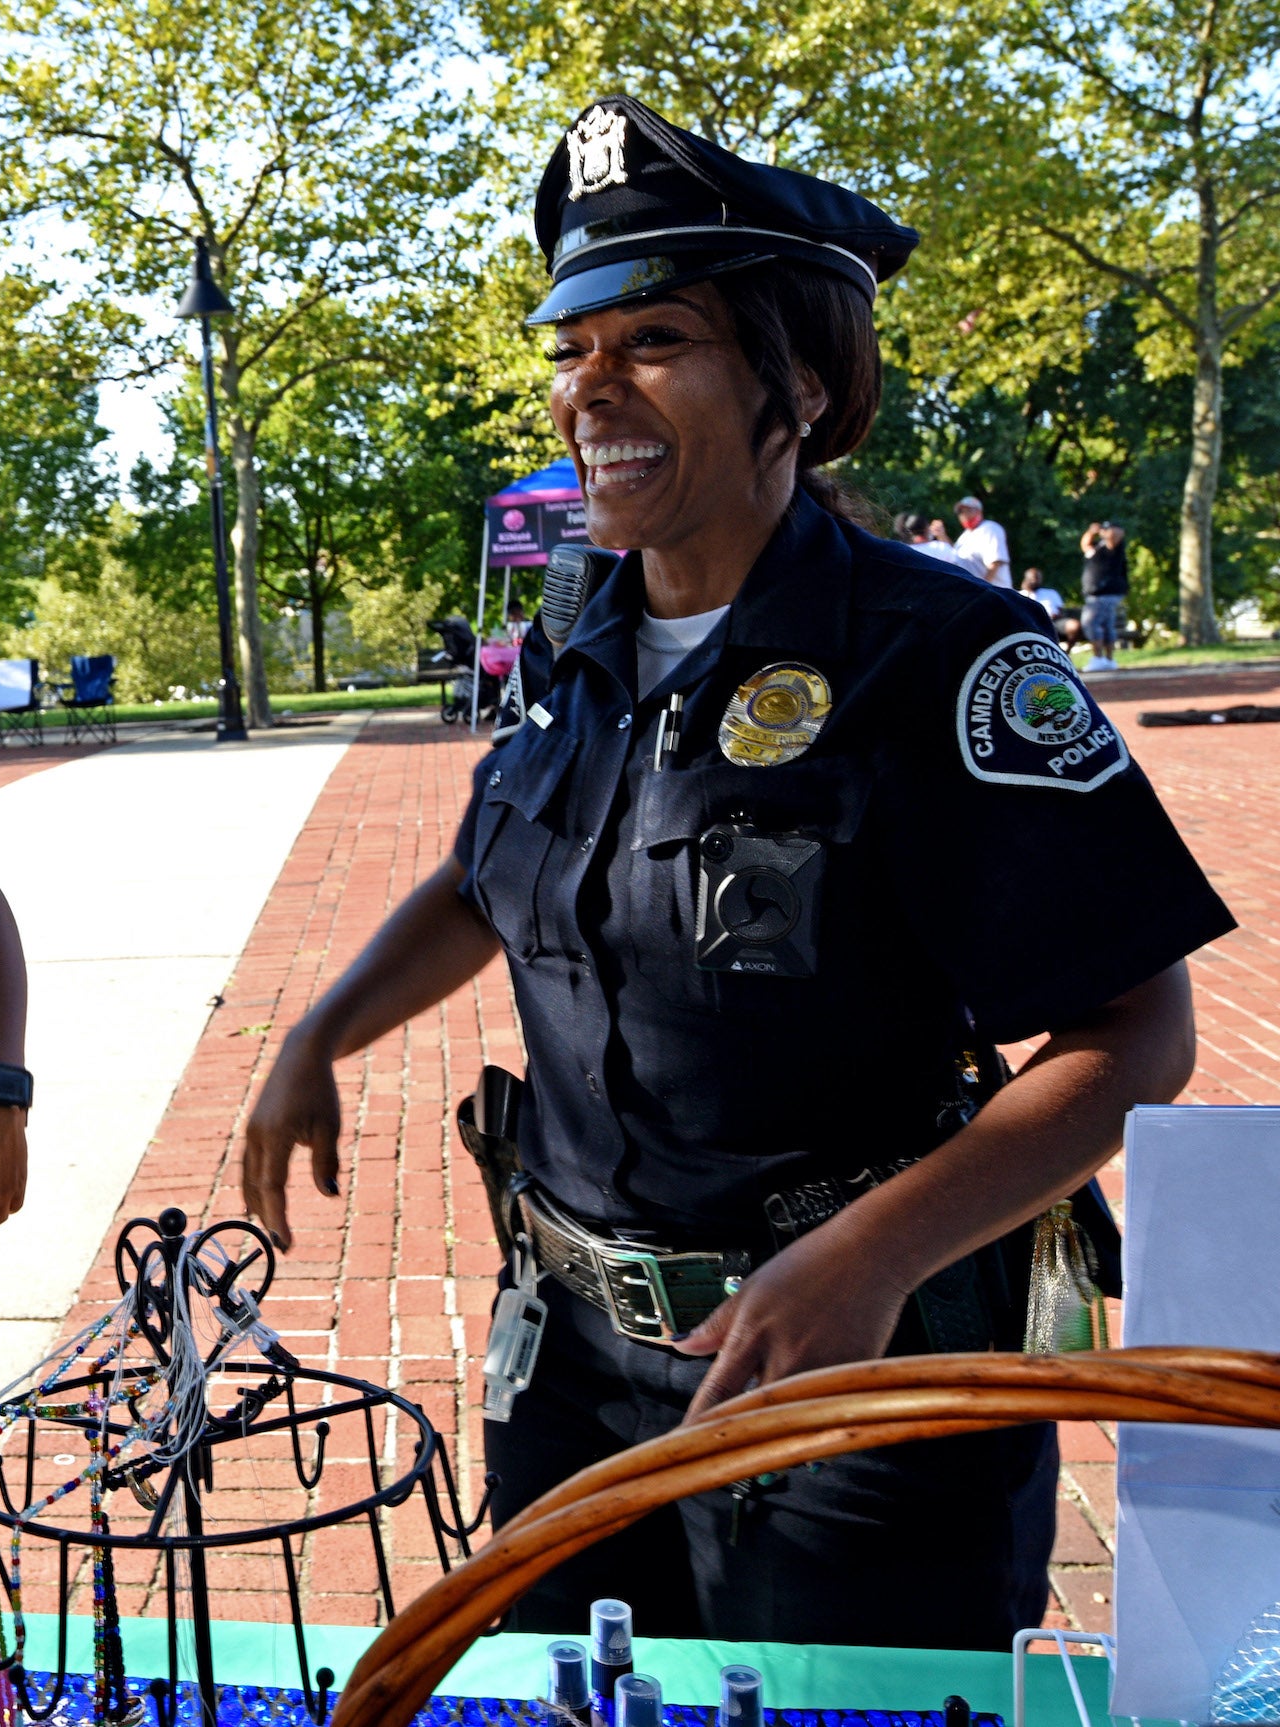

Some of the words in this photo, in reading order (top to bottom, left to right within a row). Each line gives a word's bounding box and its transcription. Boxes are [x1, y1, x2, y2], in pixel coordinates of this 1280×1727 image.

[970, 658, 1014, 758] CAMDEN
[1004, 673, 1025, 718] CAMDEN
[1026, 665, 1070, 683] COUNTY
[1037, 732, 1066, 743] NEW
[1047, 723, 1116, 776] POLICE
[742, 960, 776, 973] AXON
